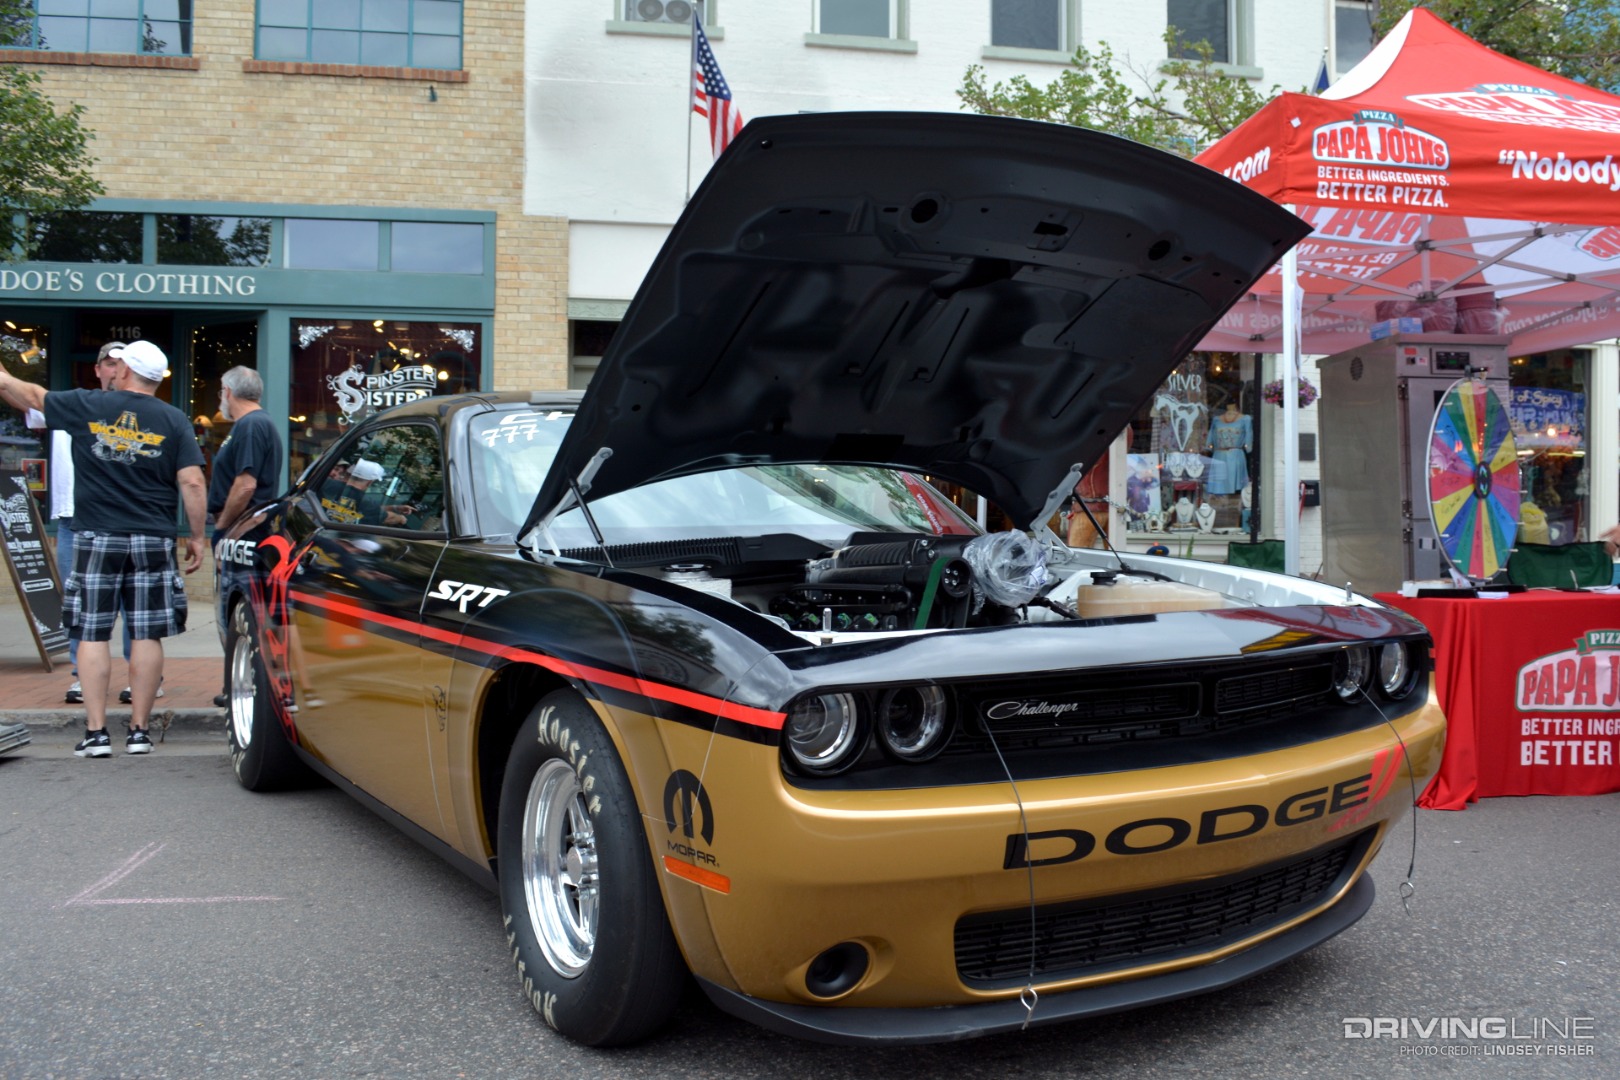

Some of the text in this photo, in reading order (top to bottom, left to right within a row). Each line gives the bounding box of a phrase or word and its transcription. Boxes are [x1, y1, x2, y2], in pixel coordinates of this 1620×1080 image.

[1361, 109, 1396, 123] PIZZA
[1316, 126, 1374, 161] PAPA
[1317, 165, 1450, 187] BETTER INGREDIENTS.
[1316, 181, 1449, 208] BETTER PIZZA.
[0, 268, 256, 296] DOE'S CLOTHING
[109, 326, 141, 340] 1116
[481, 423, 540, 448] 777
[215, 538, 256, 566] DODGE
[428, 580, 511, 613] SRT
[1522, 655, 1598, 706] PAPA
[986, 701, 1079, 720] Challenger
[1521, 718, 1583, 736] BETTER
[1520, 740, 1613, 766] BETTER
[1002, 772, 1373, 871] DODGE
